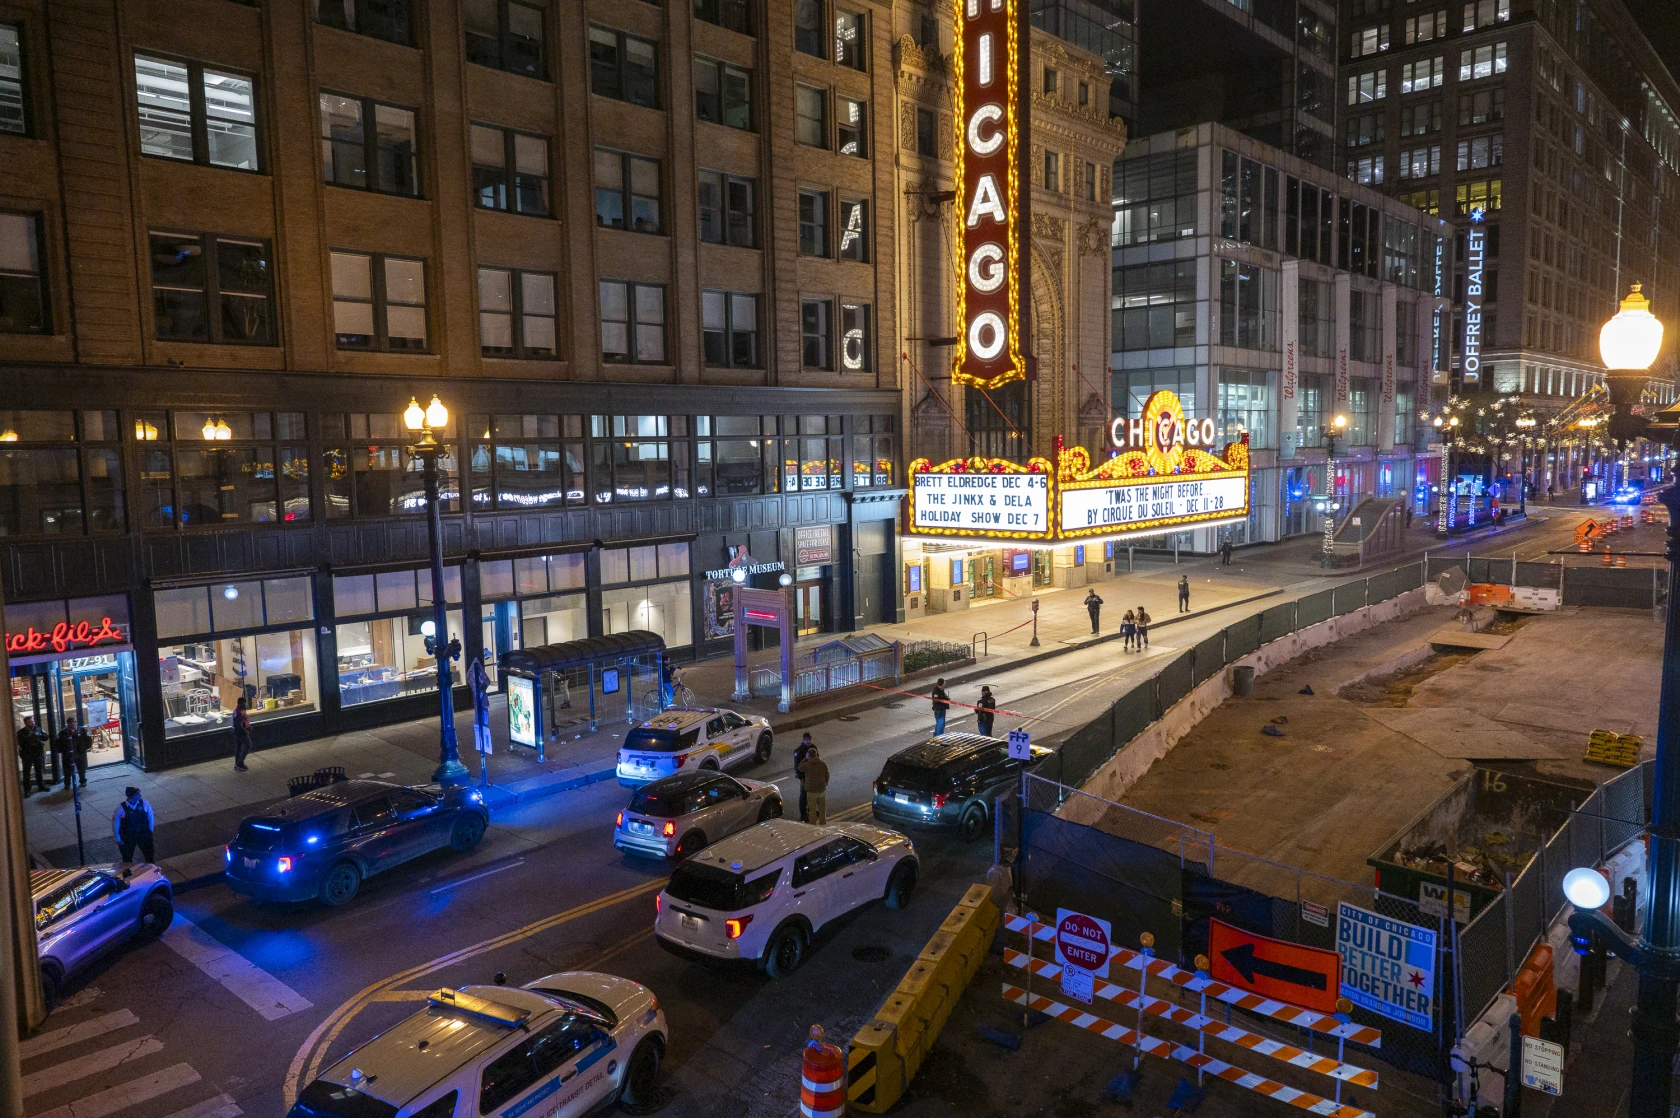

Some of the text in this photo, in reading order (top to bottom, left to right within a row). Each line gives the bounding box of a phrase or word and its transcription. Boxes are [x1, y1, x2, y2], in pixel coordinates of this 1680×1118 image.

[1464, 229, 1484, 380] JOFFREY BALLET
[1284, 341, 1298, 401] Walgreens
[1338, 348, 1349, 403] Walgreens
[1384, 353, 1395, 404] Walgreens
[1420, 358, 1430, 406] Walgreens
[1111, 417, 1215, 447] CHICAGO
[915, 476, 1047, 488] BRETT ELDREDGE DEC 4-6
[927, 493, 1032, 507] THE JINKX & DELA
[1105, 490, 1132, 505] 'TWAS
[1135, 487, 1150, 502] THE
[1152, 485, 1173, 500] NIGHT
[920, 510, 1039, 525] HOLIDAY SHOW DEC 7
[1087, 509, 1098, 525] BY
[1102, 505, 1133, 522] CIRQUE
[1138, 503, 1148, 518] DU
[1151, 501, 1175, 517] SOLEIL
[1186, 499, 1198, 512] DEC
[797, 540, 809, 549] SPACE
[818, 538, 829, 547] LEASE
[749, 561, 785, 576] MUSEUM
[67, 655, 109, 669] 177-91
[1016, 745, 1022, 754] 9
[1484, 770, 1507, 793] 16
[1065, 921, 1102, 940] DO NOT
[1341, 906, 1363, 921] CITY
[1368, 915, 1379, 926] OF
[1385, 921, 1431, 943] CHICAGO
[1339, 918, 1402, 961] BUILD
[1067, 946, 1097, 963] ENTER
[1338, 942, 1402, 984] BETTER
[1341, 965, 1429, 1016] TOGETHER
[1341, 988, 1426, 1026] AYOR BRANDON JOHNSON
[1535, 1045, 1560, 1057] STOPPING
[1535, 1061, 1559, 1073] STANDING
[559, 1085, 583, 1109] TRANSIT
[585, 1071, 604, 1090] DETAIL
[1535, 1077, 1558, 1088] PARKING
